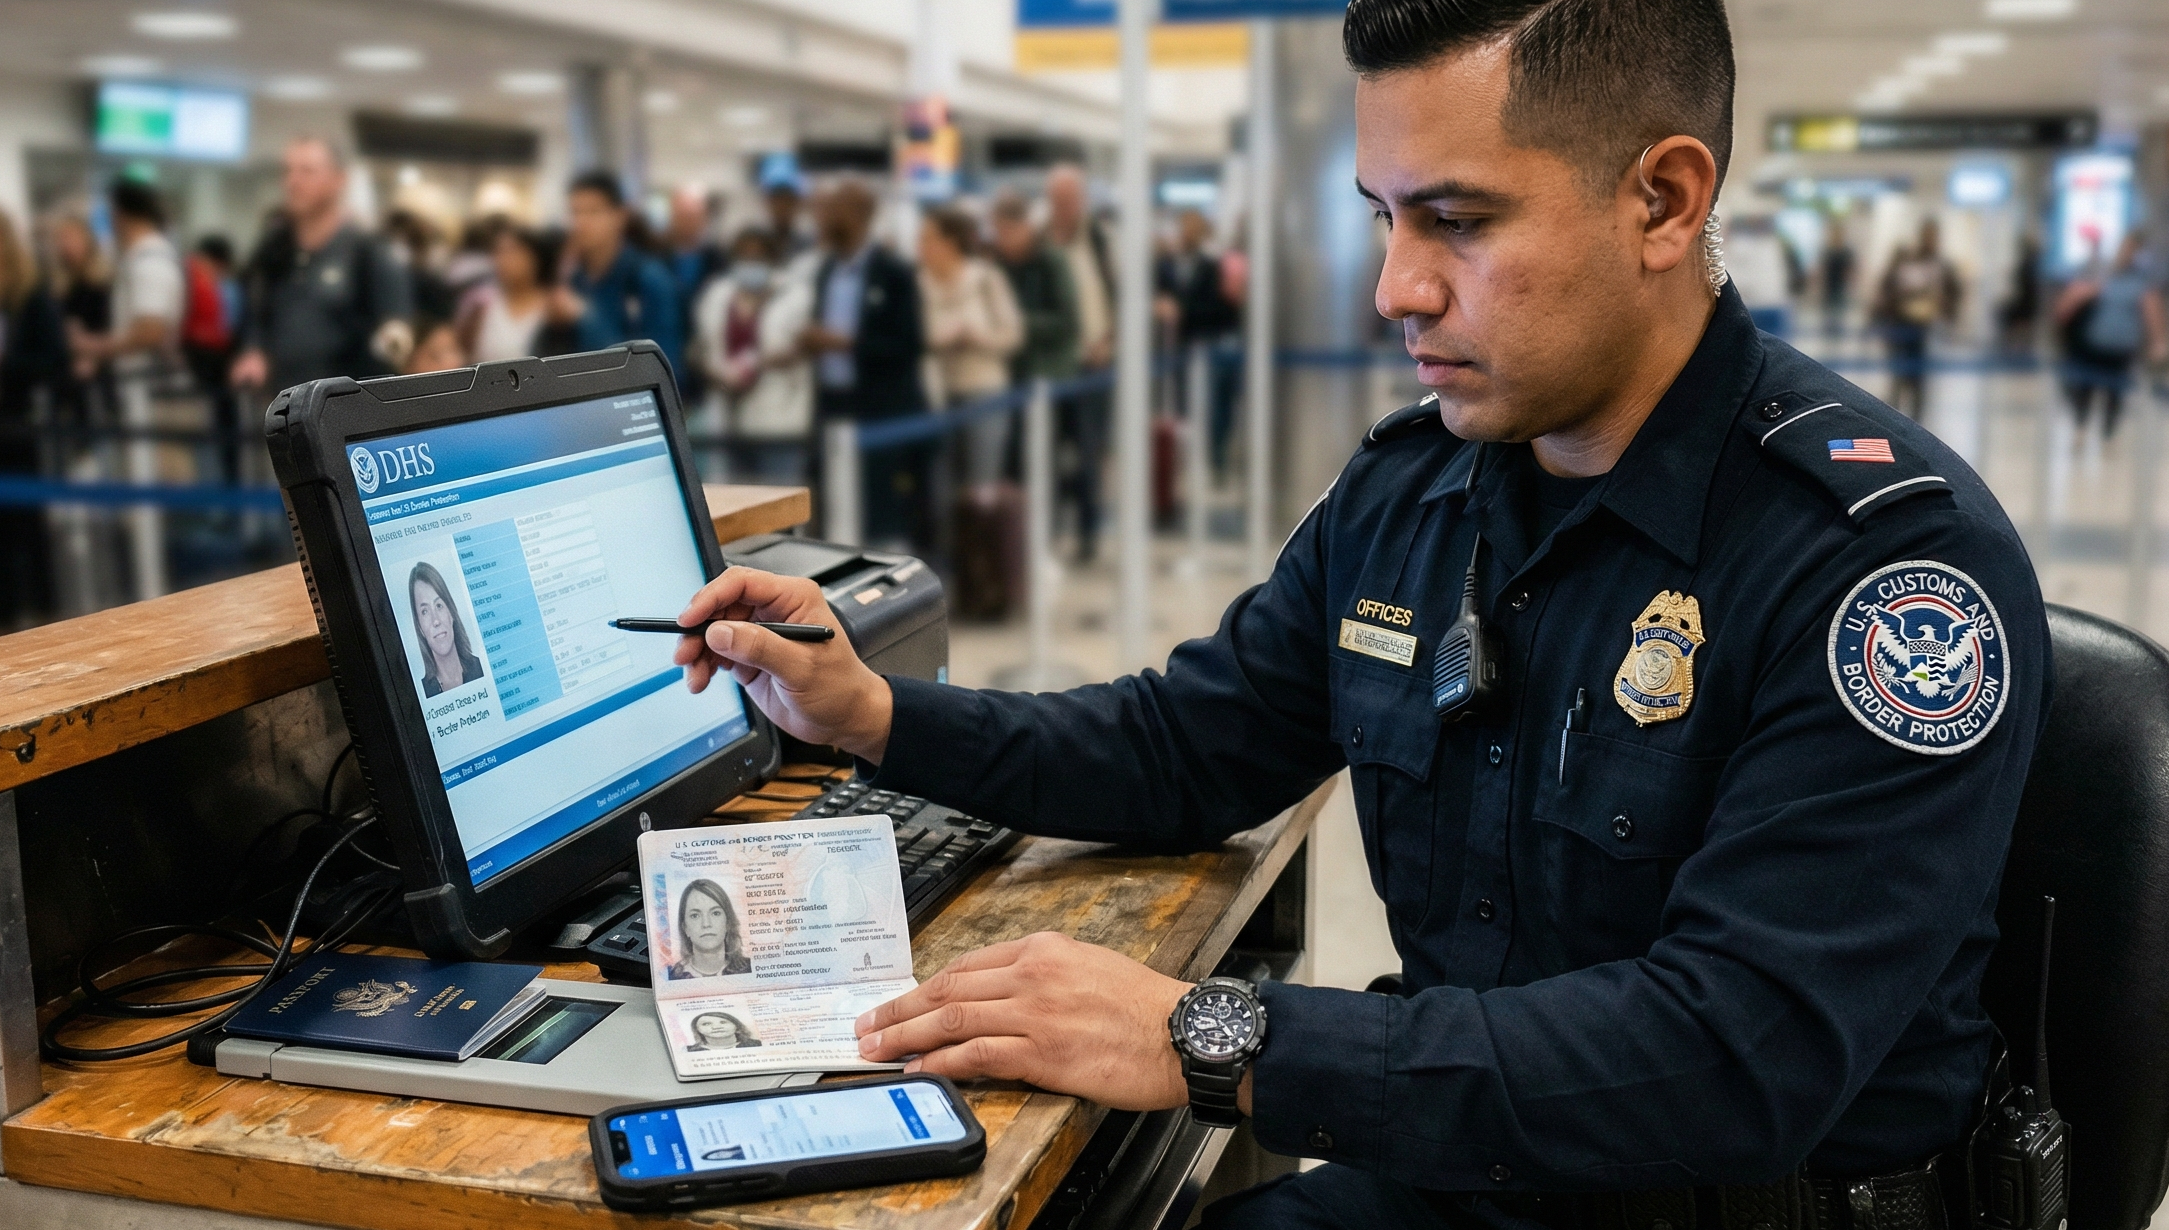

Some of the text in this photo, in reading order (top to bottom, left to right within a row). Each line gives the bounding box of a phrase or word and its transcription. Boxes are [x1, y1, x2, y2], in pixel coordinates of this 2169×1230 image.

[377, 442, 435, 484] DHS
[1356, 598, 1413, 627] OFFICES
[1878, 573, 1966, 603] CUSTOMS
[1965, 603, 1995, 641] AND
[1842, 662, 2000, 742] BORDER PROTECTION
